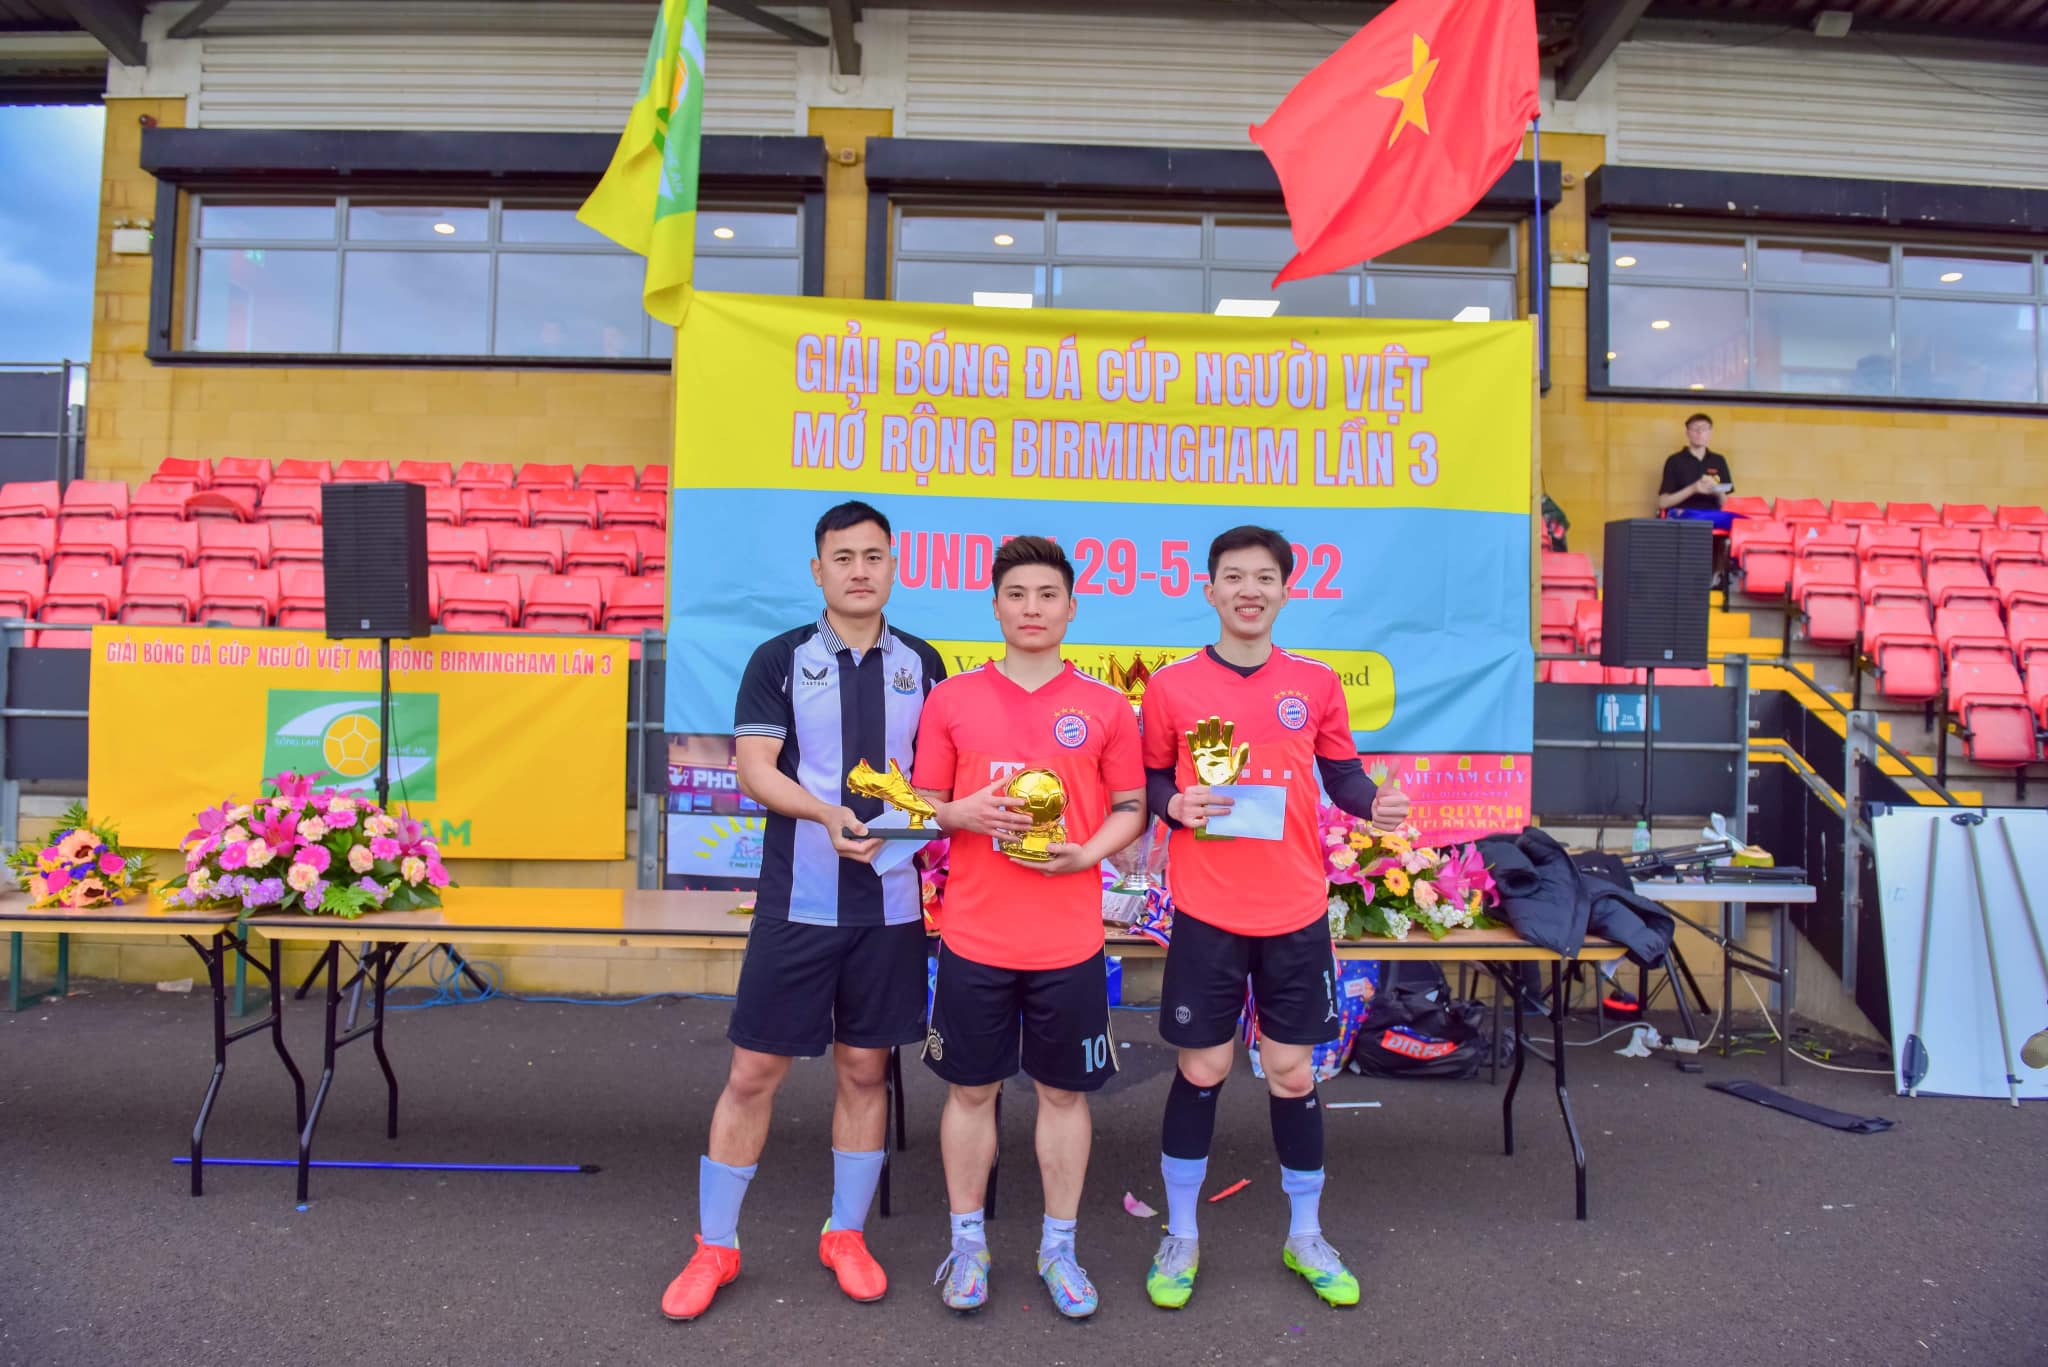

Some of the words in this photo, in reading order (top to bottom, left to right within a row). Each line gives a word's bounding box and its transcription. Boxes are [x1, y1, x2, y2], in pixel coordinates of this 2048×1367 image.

[795, 320, 880, 394] GIẢI
[894, 328, 1010, 398] BÓNG
[1024, 334, 1082, 400] ĐÁ
[1097, 336, 1181, 403] CÚP
[1195, 338, 1328, 410] NGƯỜI
[1341, 343, 1430, 425] VIỆT
[791, 394, 867, 471] MỞ
[880, 401, 996, 487] RỘNG
[1011, 418, 1298, 486] BIRMINGHAM
[1408, 431, 1439, 487] 3
[891, 530, 1056, 591] UND
[1073, 537, 1344, 600] 29-5-22
[218, 640, 251, 666] CÚP
[440, 649, 556, 674] BIRMINGHAM
[600, 653, 612, 676] 3
[1339, 665, 1370, 687] ad
[1404, 770, 1478, 784] VIETNAM
[1485, 769, 1526, 784] CITY
[1081, 1034, 1107, 1073] 10
